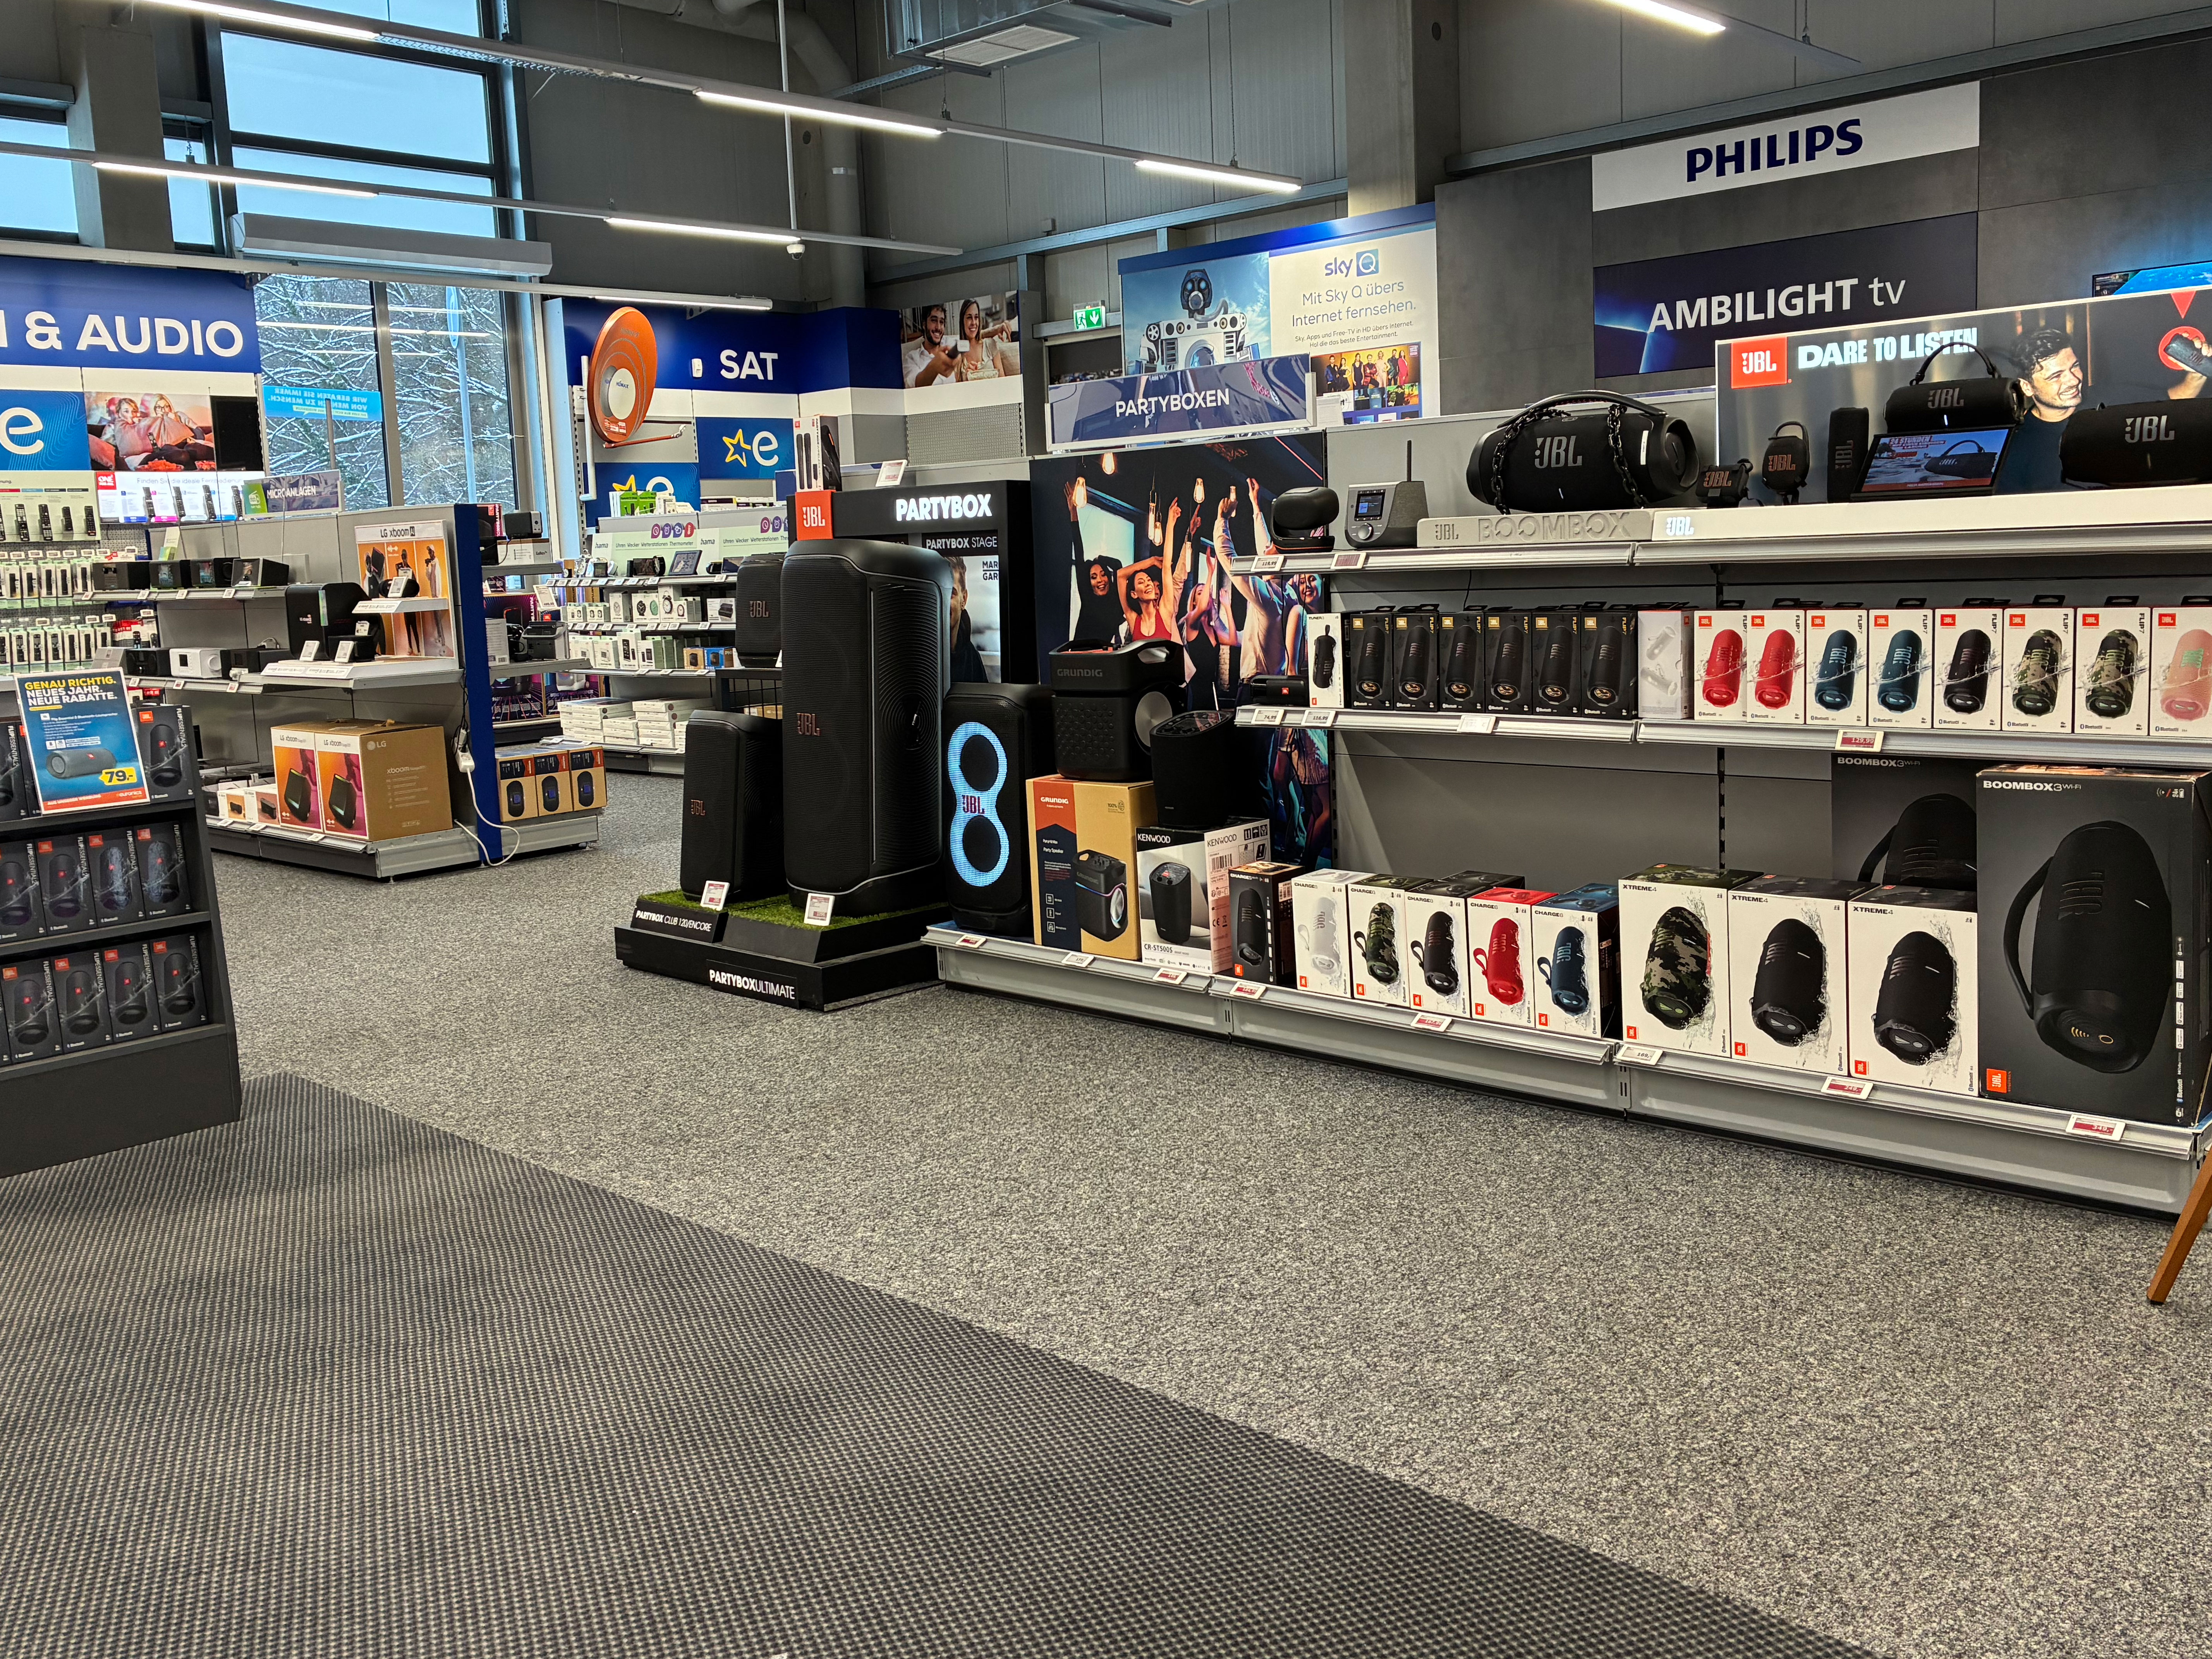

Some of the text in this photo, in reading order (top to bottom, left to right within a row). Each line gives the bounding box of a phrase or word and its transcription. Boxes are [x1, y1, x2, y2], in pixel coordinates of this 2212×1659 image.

[1687, 119, 1862, 182] PHILIPS
[1325, 252, 1376, 277] sky Q
[1303, 281, 1404, 306] Mit Sky Q übers
[1293, 299, 1416, 326] Internet fernsehen.
[1649, 277, 1906, 332] AMBILIGHT tv
[25, 311, 62, 350] &
[76, 314, 243, 357] AUDIO
[1307, 333, 1320, 342] Apps
[1333, 328, 1355, 337] Free-TV
[1742, 327, 1977, 374] JBL DARE TO LISTEN
[720, 349, 778, 380] SAT
[1116, 388, 1229, 417] PARTYBOXEN
[1927, 388, 1964, 409] JBL
[2125, 416, 2175, 443] JBL
[1534, 435, 1582, 469] JBL
[1835, 440, 1853, 469] JBL
[1768, 454, 1796, 472] JBL
[1704, 471, 1731, 487] JBL
[267, 486, 316, 499] MICROANLAGEN
[802, 506, 825, 527] JBL
[896, 494, 992, 521] PARTYBOX
[380, 529, 387, 538] LG
[389, 528, 409, 538] xboom
[1435, 524, 1459, 540] JBL
[1479, 512, 1631, 542] BOOMBOX
[1666, 517, 1694, 536] JBL
[926, 536, 997, 549] PARTYBOX STAGE
[982, 561, 998, 569] MAR
[749, 601, 769, 618] JBL
[1057, 669, 1103, 677] GRUNDIG
[25, 676, 117, 690] GENAU RICHTIG.
[26, 685, 103, 699] NEUES JAHR.
[28, 691, 118, 706] NEUE RABATTE.
[797, 713, 821, 736] JBL
[105, 770, 133, 783] 79,-
[691, 800, 706, 816] JBL
[962, 795, 985, 814] JBL
[1137, 833, 1171, 843] KENWOOD
[1207, 834, 1237, 847] KENWOOD
[1622, 884, 1657, 892] XTREME4
[1732, 895, 1769, 903] XTREME4
[1853, 906, 1894, 915] XTREME4
[636, 910, 712, 932] PARTYBOX CLUB 120/ENCORE
[1992, 1073, 2001, 1087] JBL
